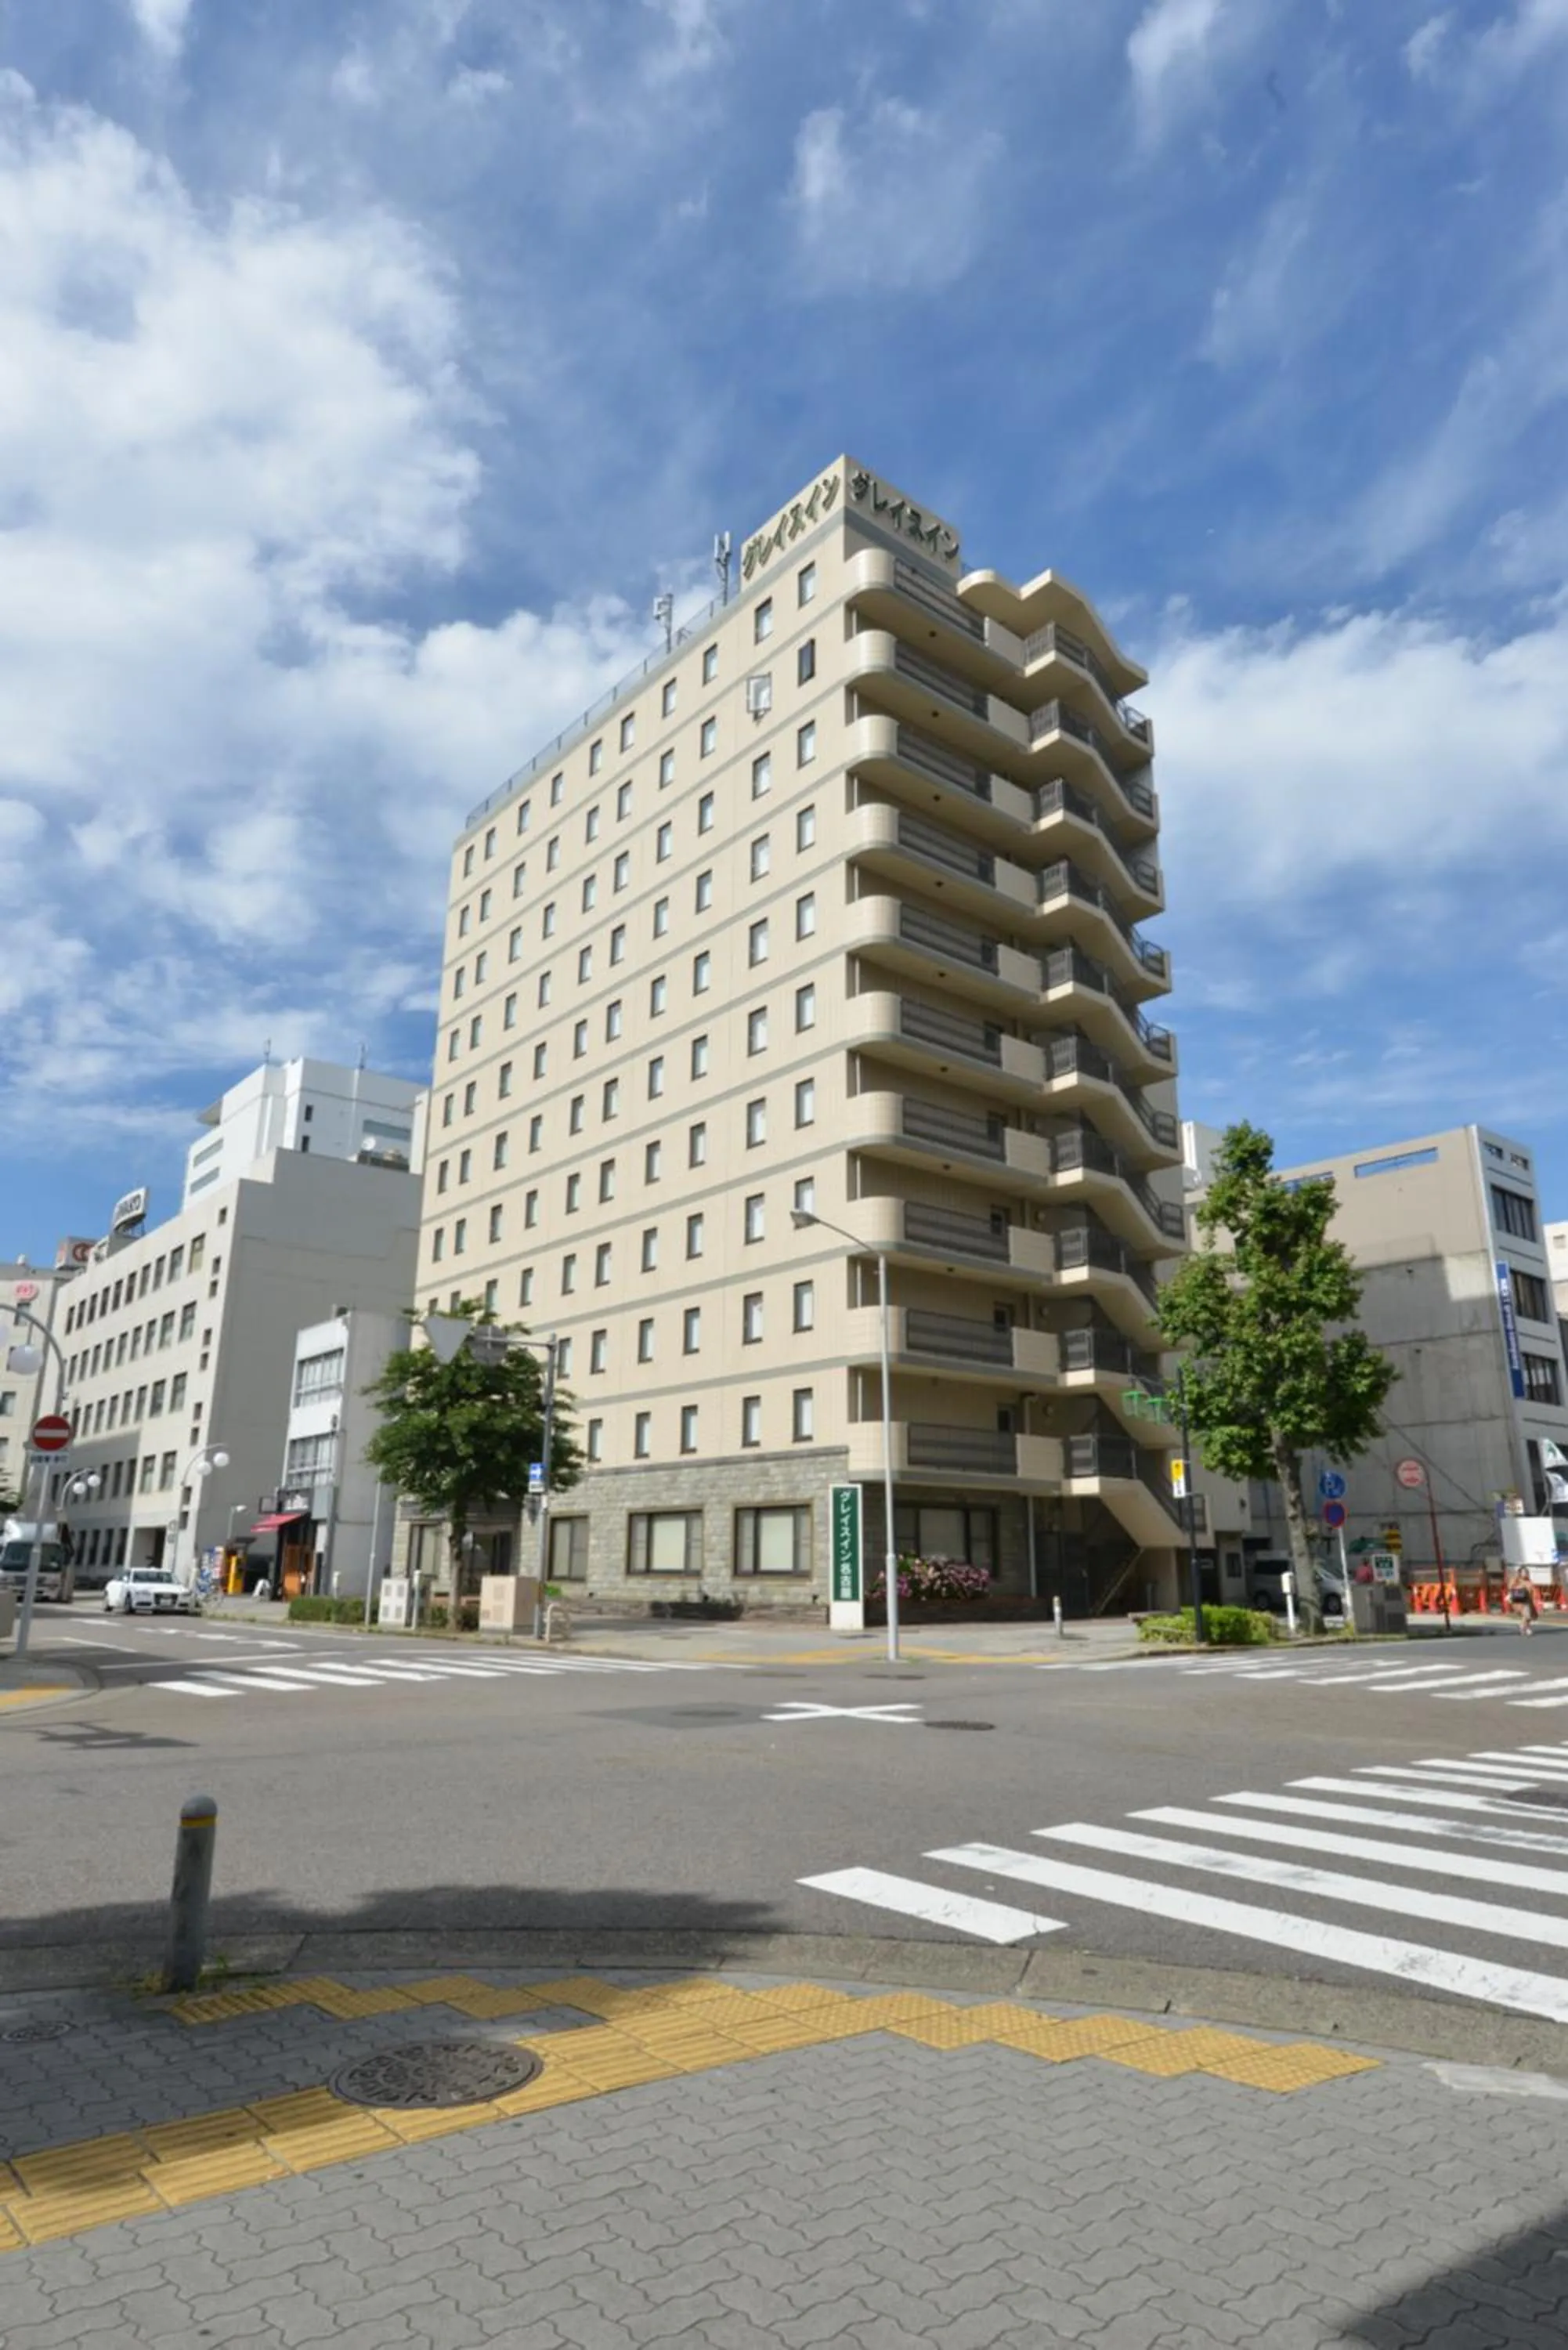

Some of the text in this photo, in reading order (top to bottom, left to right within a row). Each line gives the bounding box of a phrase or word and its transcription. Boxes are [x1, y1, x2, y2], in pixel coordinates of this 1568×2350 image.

[742, 474, 840, 580] グレイスイン
[851, 470, 959, 561] グレイスイン
[840, 1491, 852, 1599] グレイスイン
